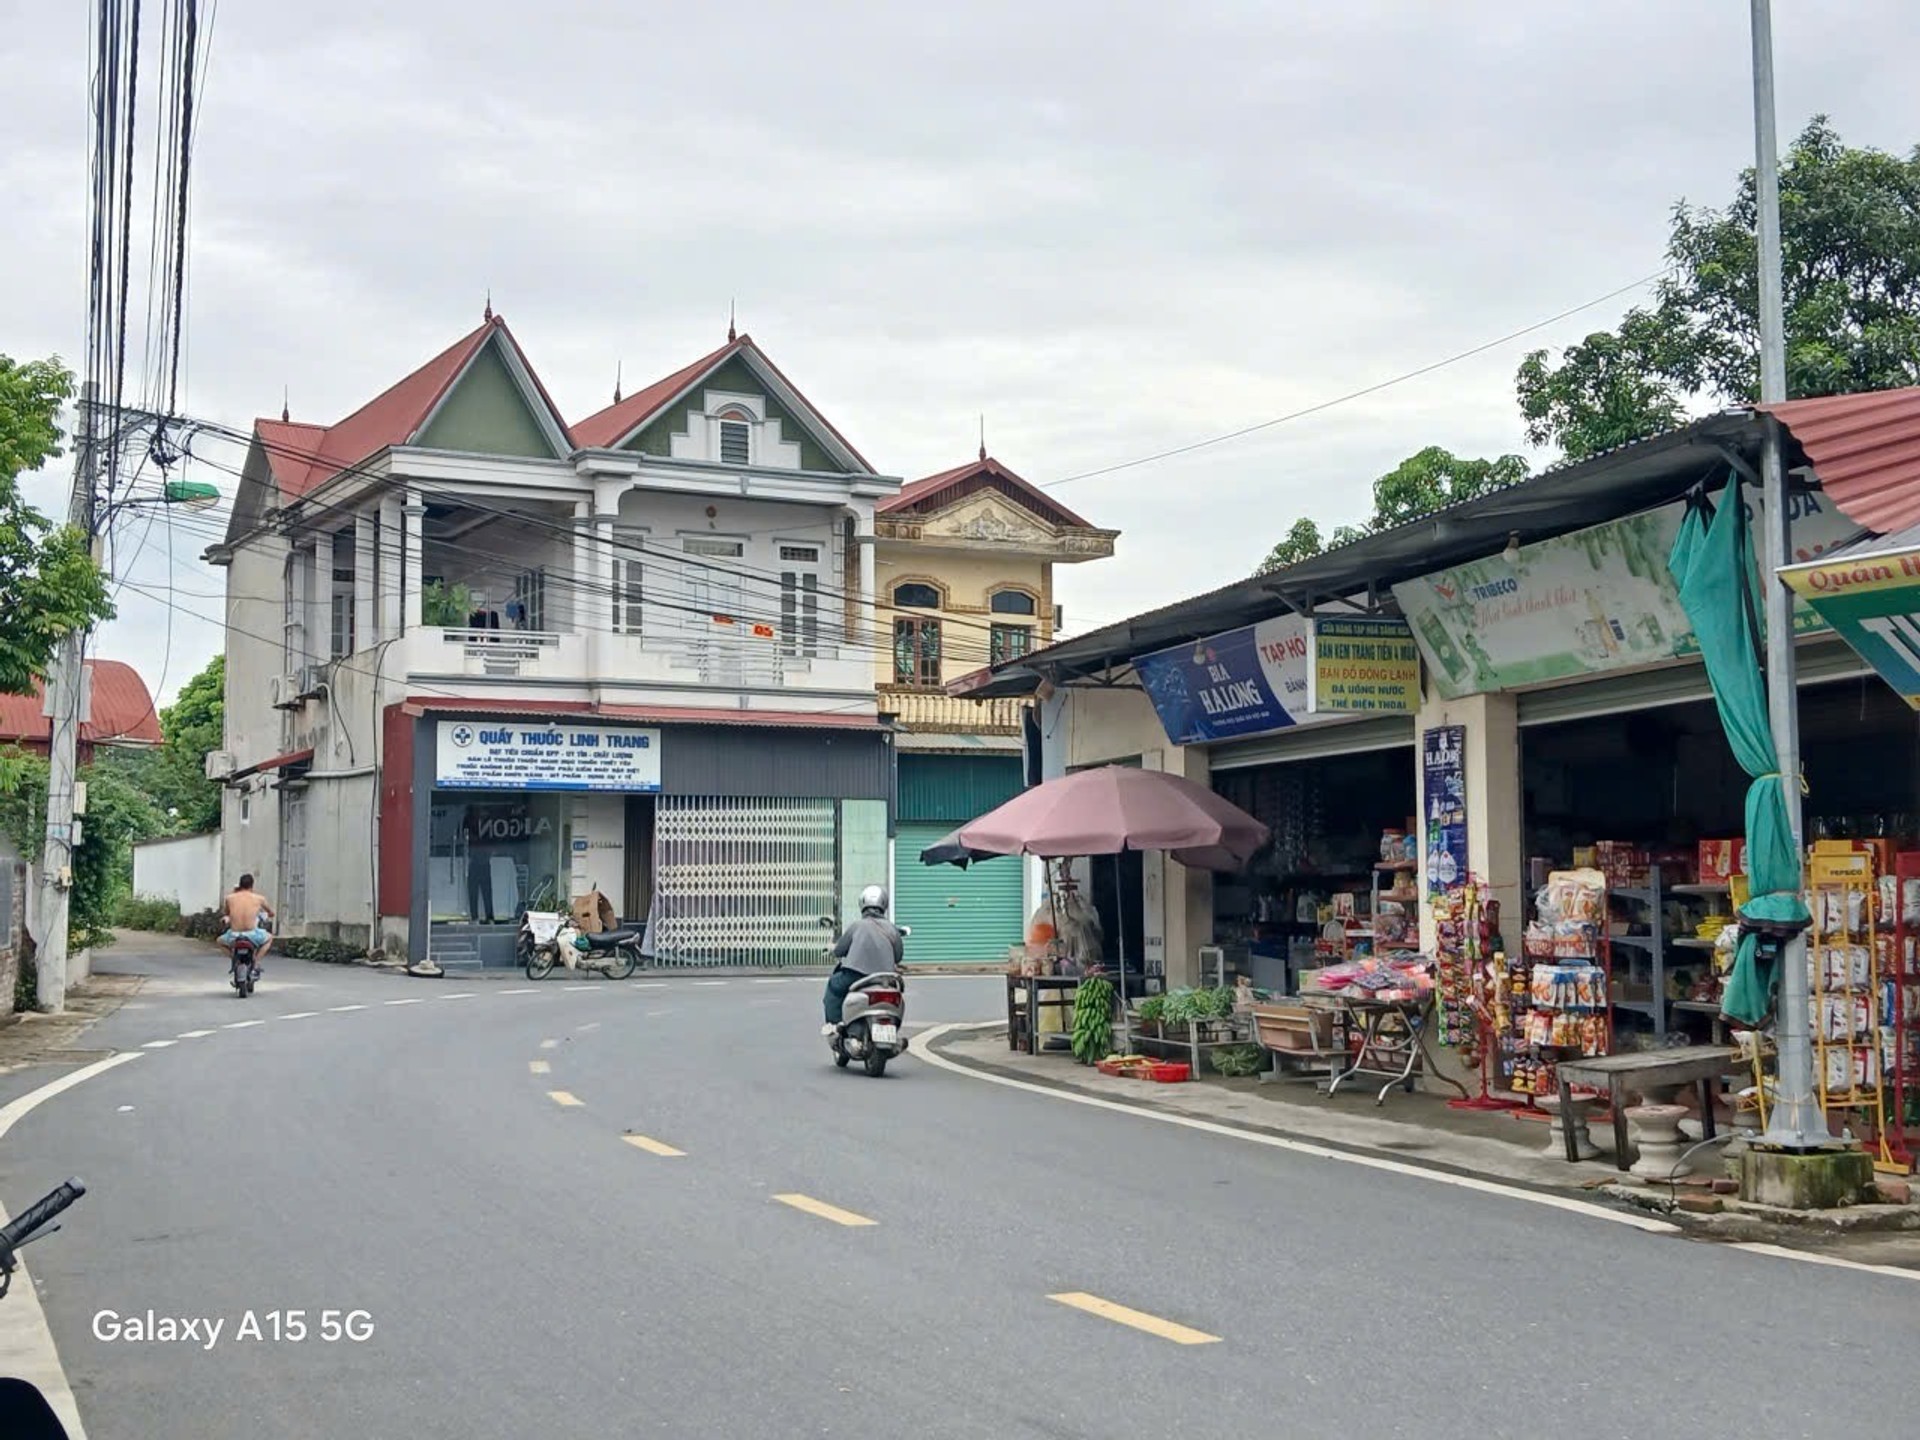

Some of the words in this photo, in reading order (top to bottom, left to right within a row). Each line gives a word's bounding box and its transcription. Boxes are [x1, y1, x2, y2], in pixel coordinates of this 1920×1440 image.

[1472, 578, 1518, 600] TRIBECO
[1807, 562, 1893, 592] Quán
[1285, 632, 1307, 658] HÓ
[1207, 663, 1231, 683] BIA
[1198, 678, 1264, 714] HALONG
[520, 728, 564, 746] THUỐC
[570, 733, 599, 747] LINH
[606, 734, 649, 749] TRANG
